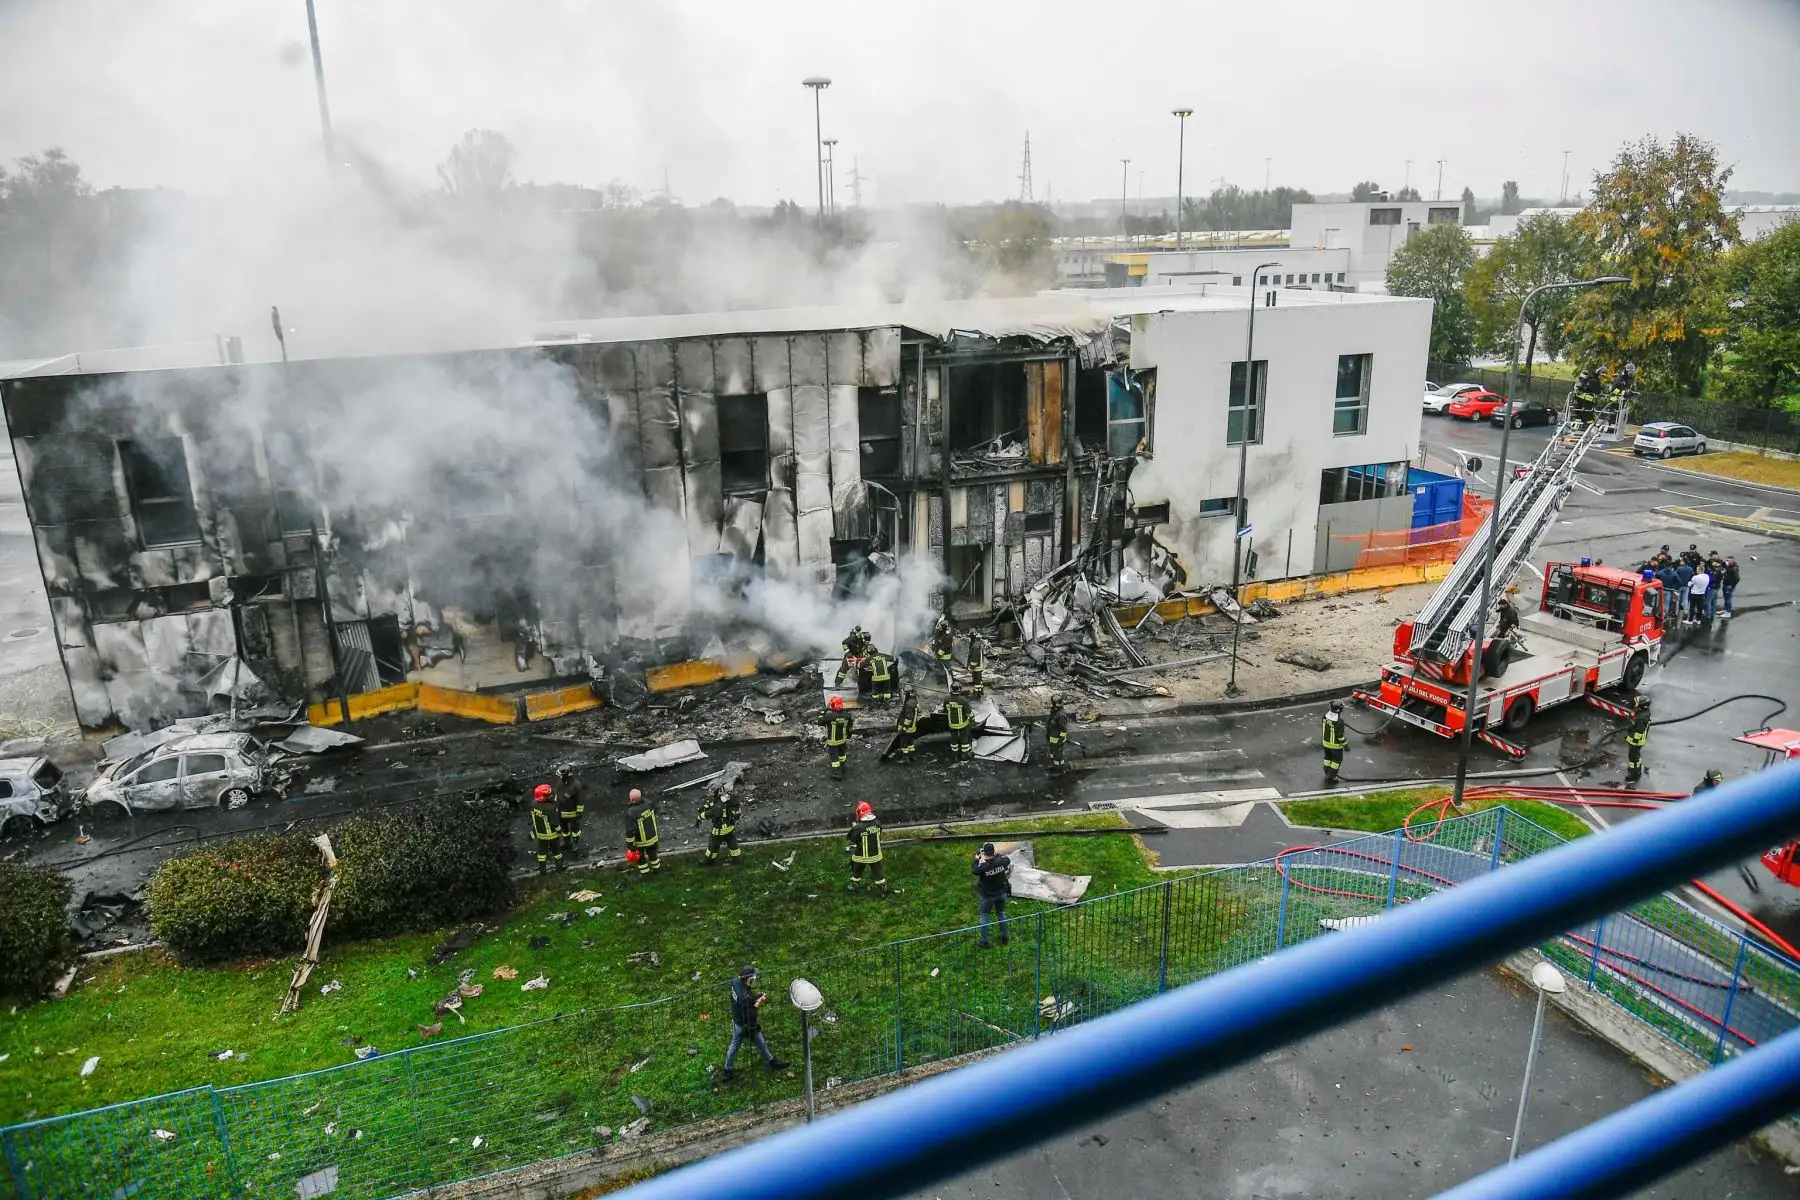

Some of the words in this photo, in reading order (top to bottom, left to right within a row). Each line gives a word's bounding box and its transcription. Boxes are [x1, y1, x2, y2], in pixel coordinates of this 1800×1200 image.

[1418, 689, 1429, 698] DEL
[1429, 694, 1448, 704] FUOCO
[985, 865, 1005, 876] POLIZIA
